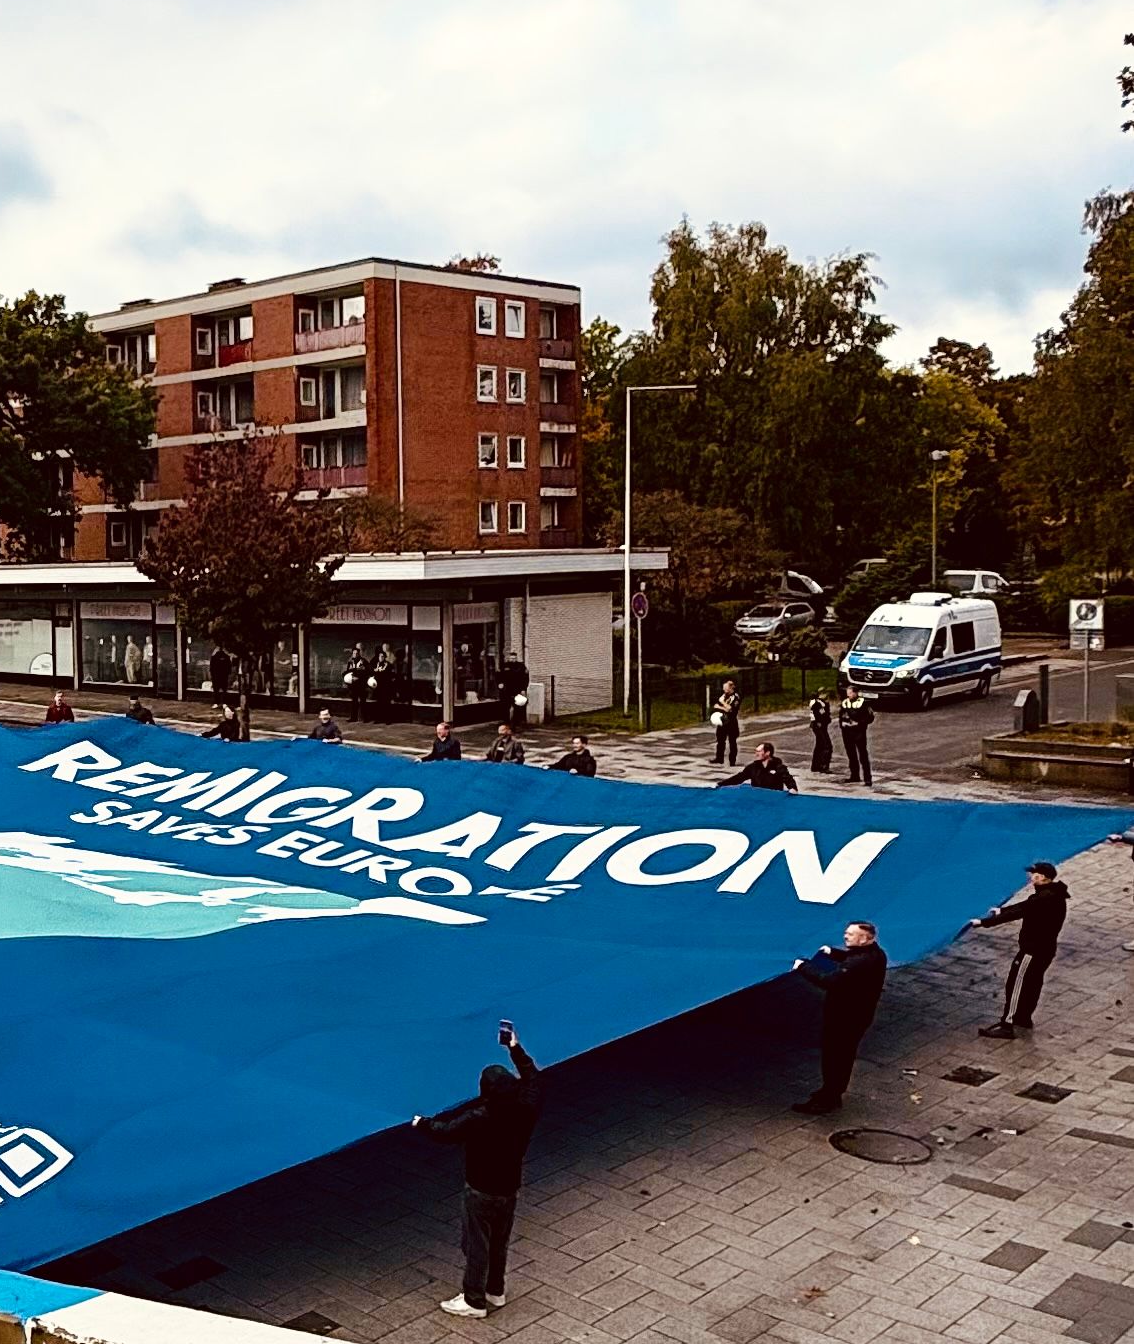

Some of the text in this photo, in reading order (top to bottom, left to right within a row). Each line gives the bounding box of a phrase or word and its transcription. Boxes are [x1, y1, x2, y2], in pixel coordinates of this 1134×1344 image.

[17, 740, 900, 905] REMIGRATION
[69, 800, 582, 902] SAVES EUROE
